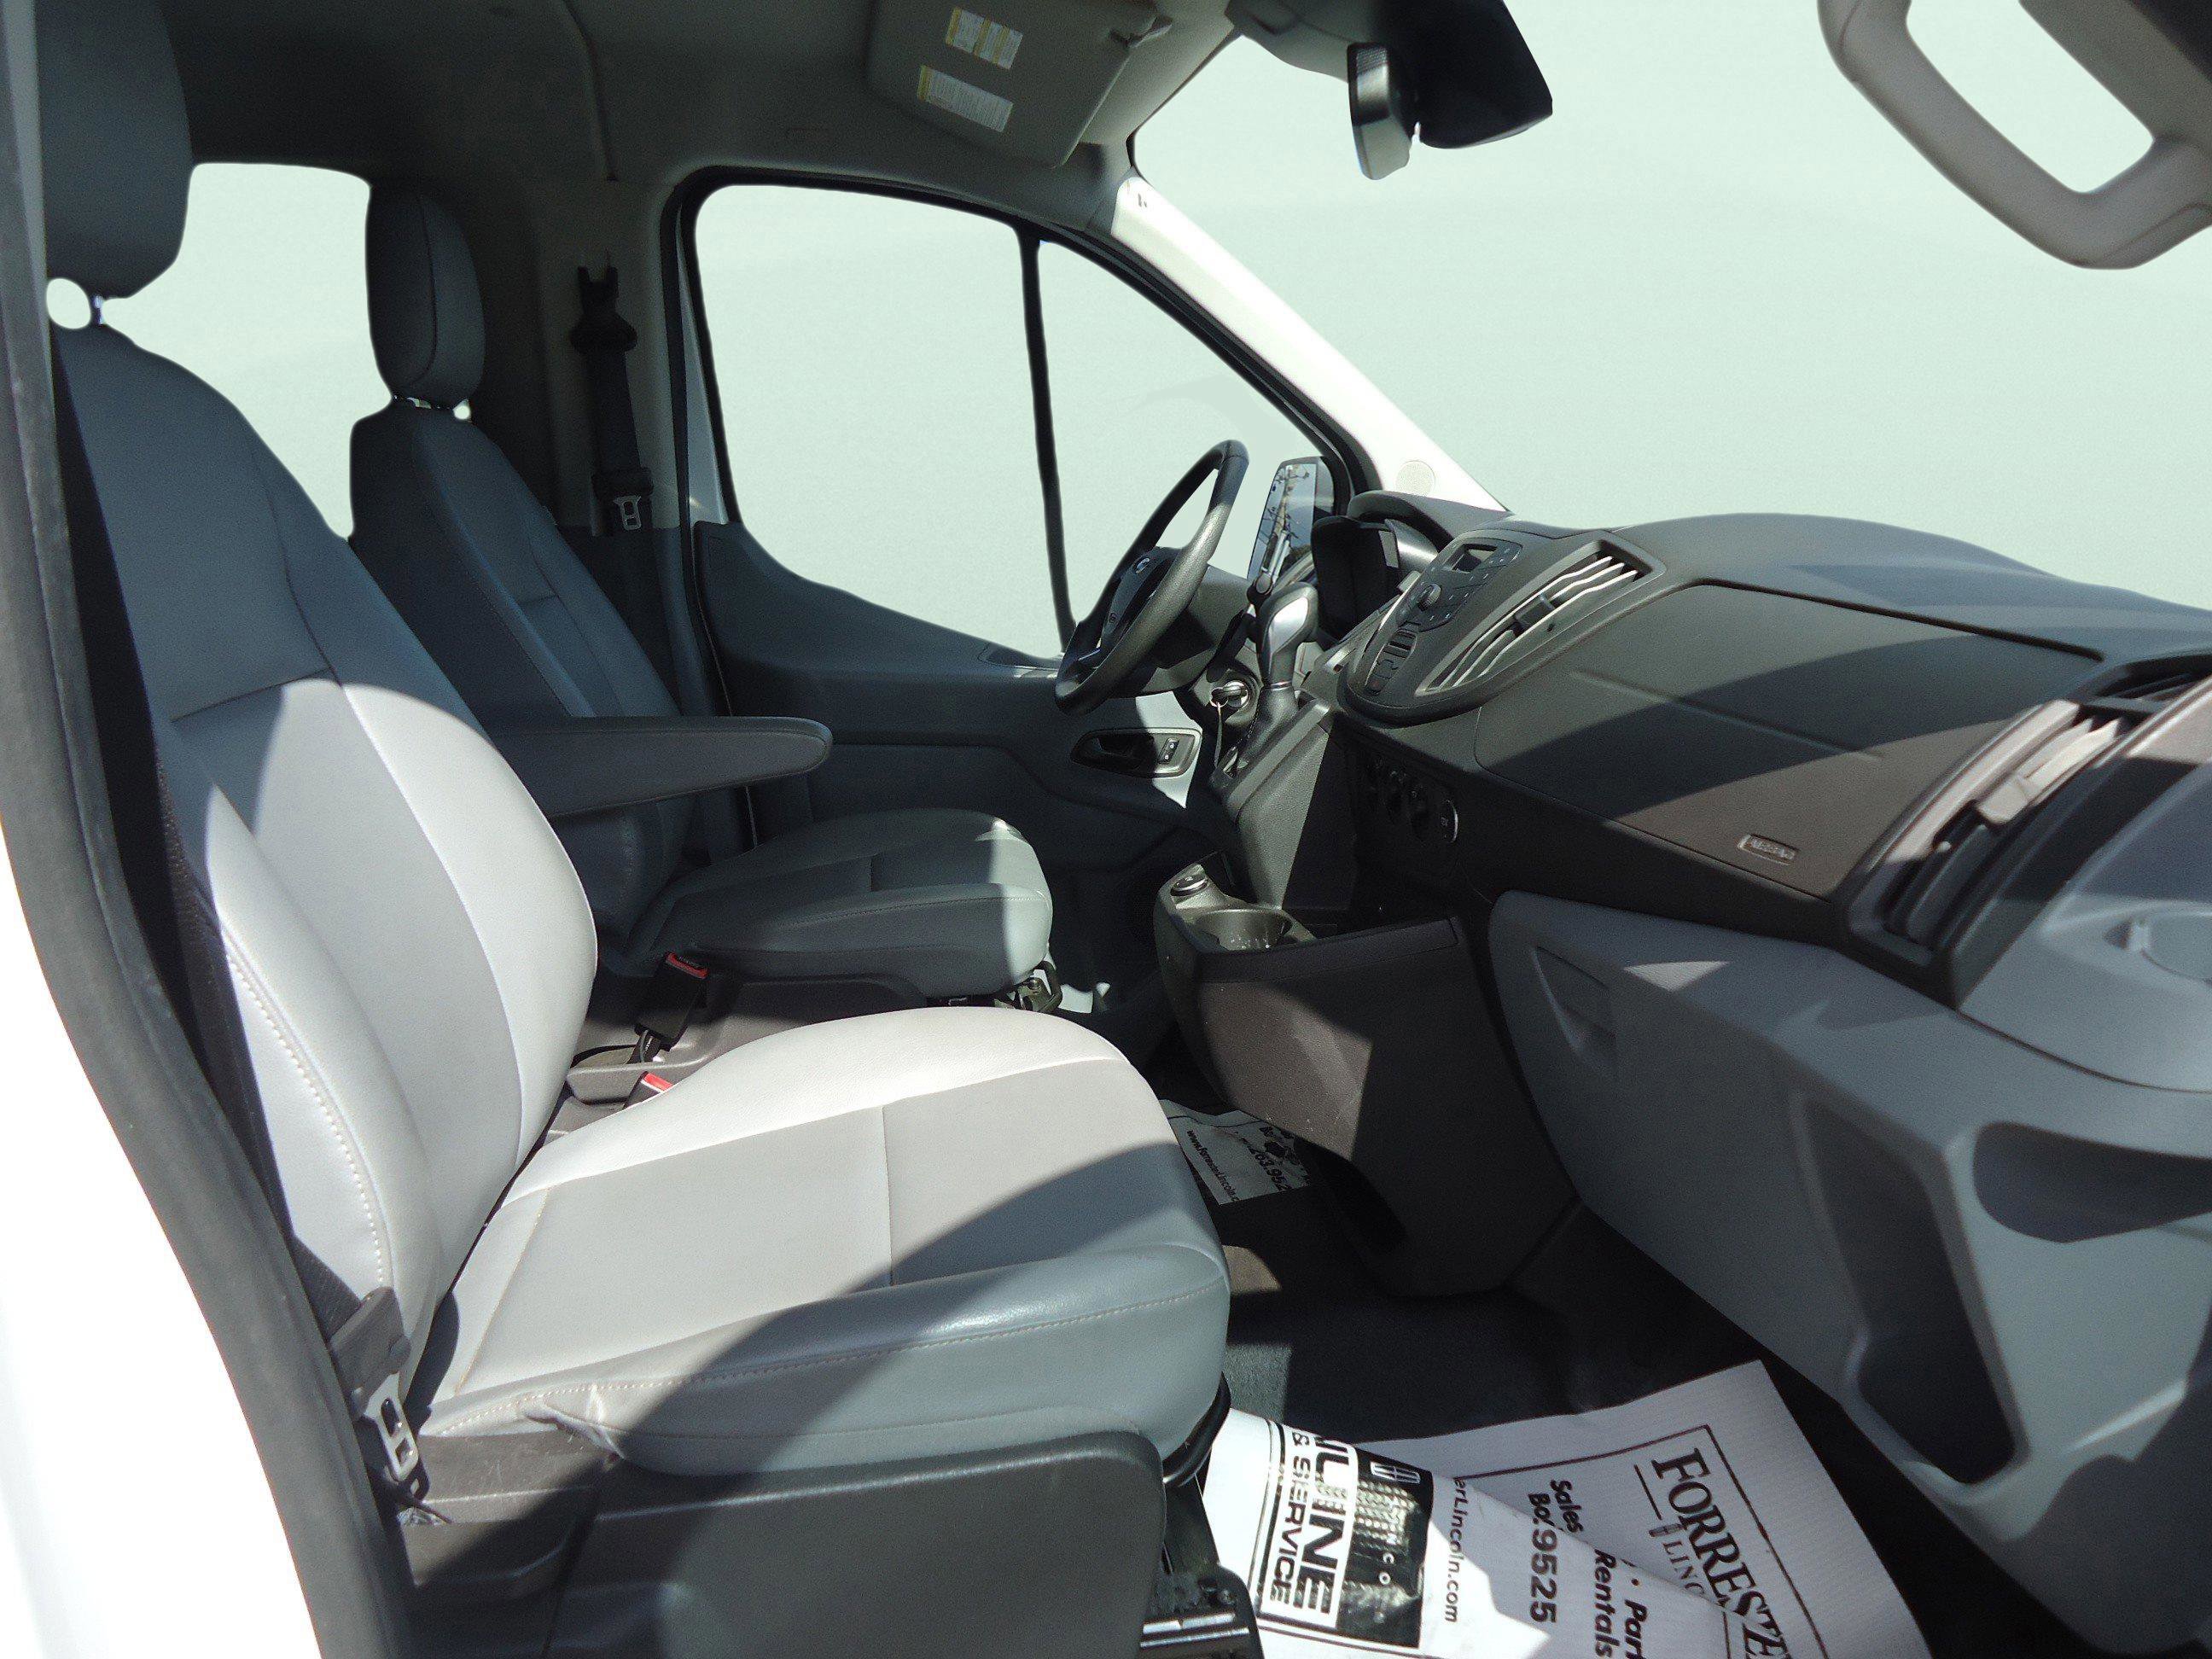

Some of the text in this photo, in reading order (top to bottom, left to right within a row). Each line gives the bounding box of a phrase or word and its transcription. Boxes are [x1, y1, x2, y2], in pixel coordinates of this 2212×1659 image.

[1270, 1455, 1311, 1605] SERVICE
[1551, 1480, 1584, 1533] Sales
[1594, 1549, 1621, 1659] Rentals
